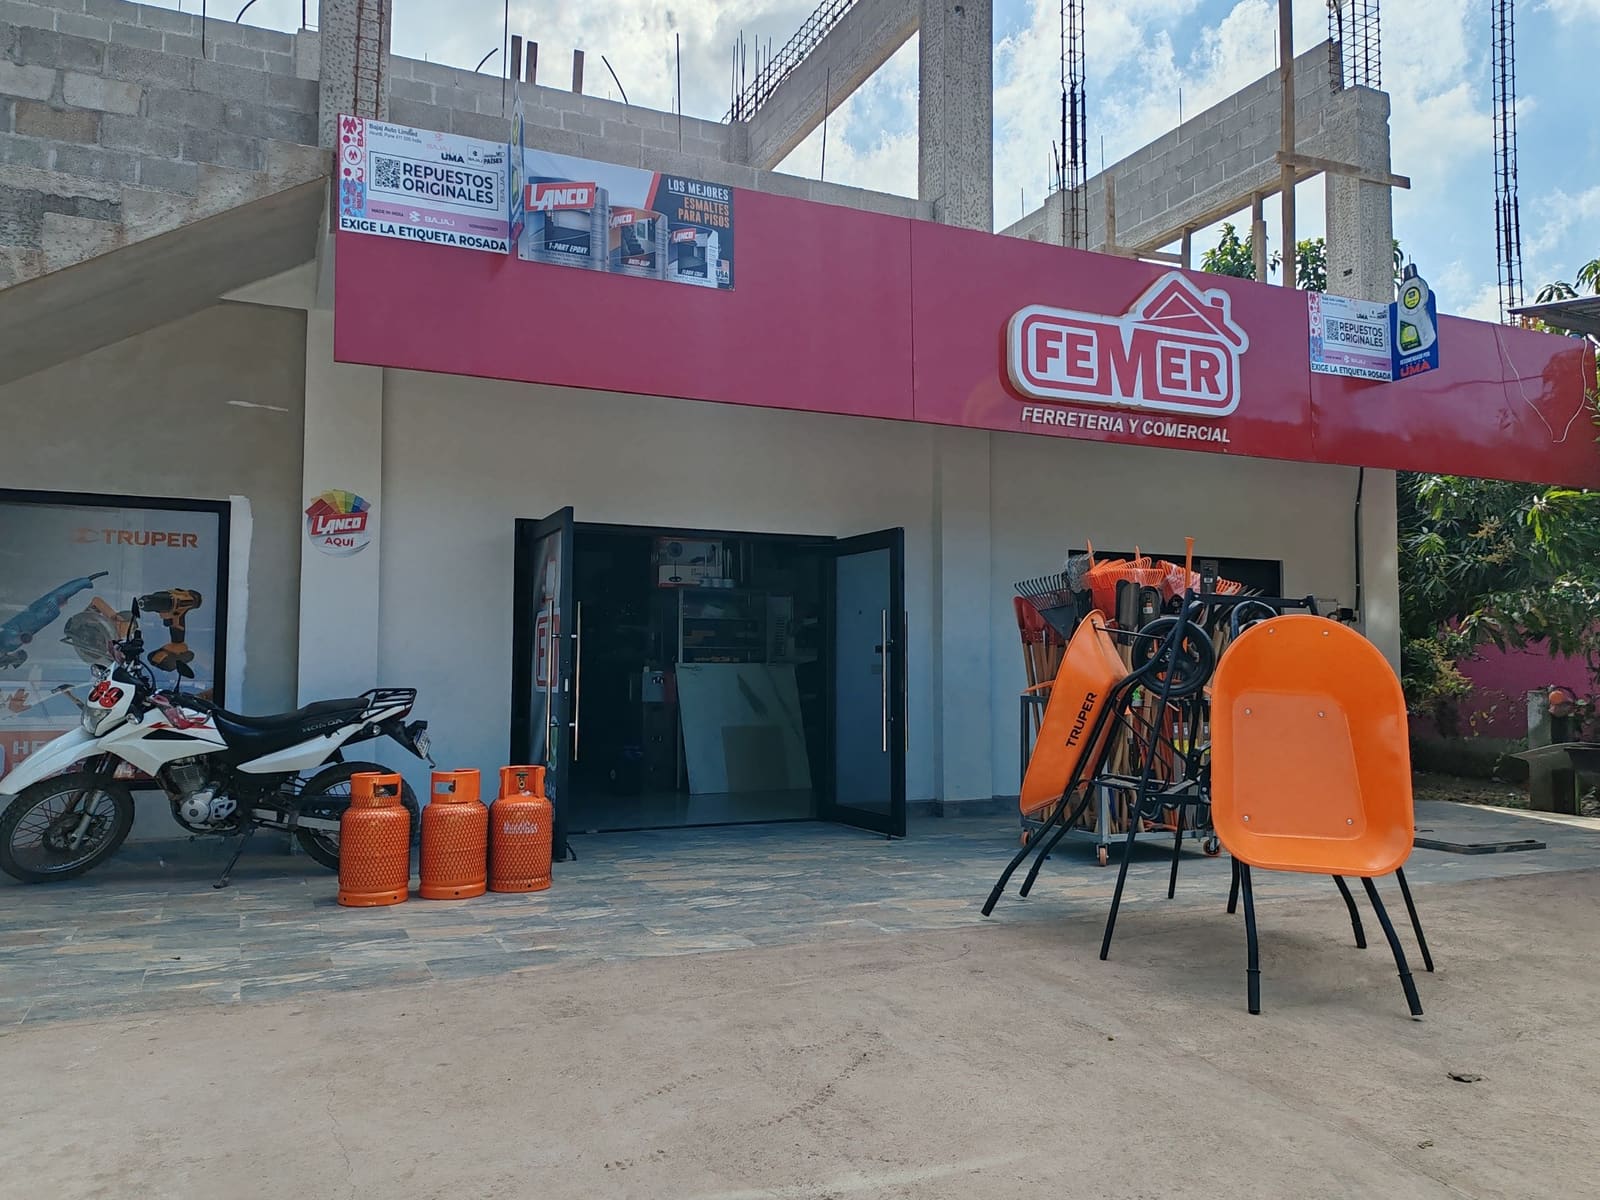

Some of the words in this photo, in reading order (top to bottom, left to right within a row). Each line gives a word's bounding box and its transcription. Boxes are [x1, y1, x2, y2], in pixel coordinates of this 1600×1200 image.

[441, 152, 465, 163] UMA
[403, 162, 493, 190] REPUESTOS
[402, 177, 494, 204] ORIGINALES
[530, 184, 588, 210] LANCO
[668, 178, 685, 192] LOS
[687, 182, 729, 201] MEJORES
[684, 196, 730, 216] ESMALTES
[424, 215, 455, 226] BAJAJ
[609, 213, 632, 229] LANCO
[678, 207, 702, 223] PARA
[704, 213, 730, 228] PISOS
[341, 217, 377, 232] EXIGE
[380, 223, 395, 235] LA
[398, 226, 456, 244] ETIQUETA
[459, 235, 507, 252] ROSADA
[673, 230, 694, 242] LANCO
[548, 242, 570, 253] 1-PART
[569, 245, 589, 254] EPOXY
[716, 269, 729, 278] USA
[1339, 321, 1383, 337] REPUESTOS
[1339, 331, 1384, 347] ORIGINALES
[1036, 325, 1221, 401] FEMER
[1311, 363, 1329, 372] EXIGE
[1330, 365, 1338, 373] LA
[1339, 366, 1367, 376] ETIQUETA
[1367, 370, 1391, 379] ROSADA
[1400, 360, 1430, 377] UMA
[1021, 406, 1124, 433] FERRETERIA
[1128, 419, 1139, 433] Y
[1142, 420, 1231, 443] COMERCIAL
[317, 515, 362, 534] LANCO
[102, 529, 198, 548] TRUPER
[1066, 692, 1097, 746] TRUPER
